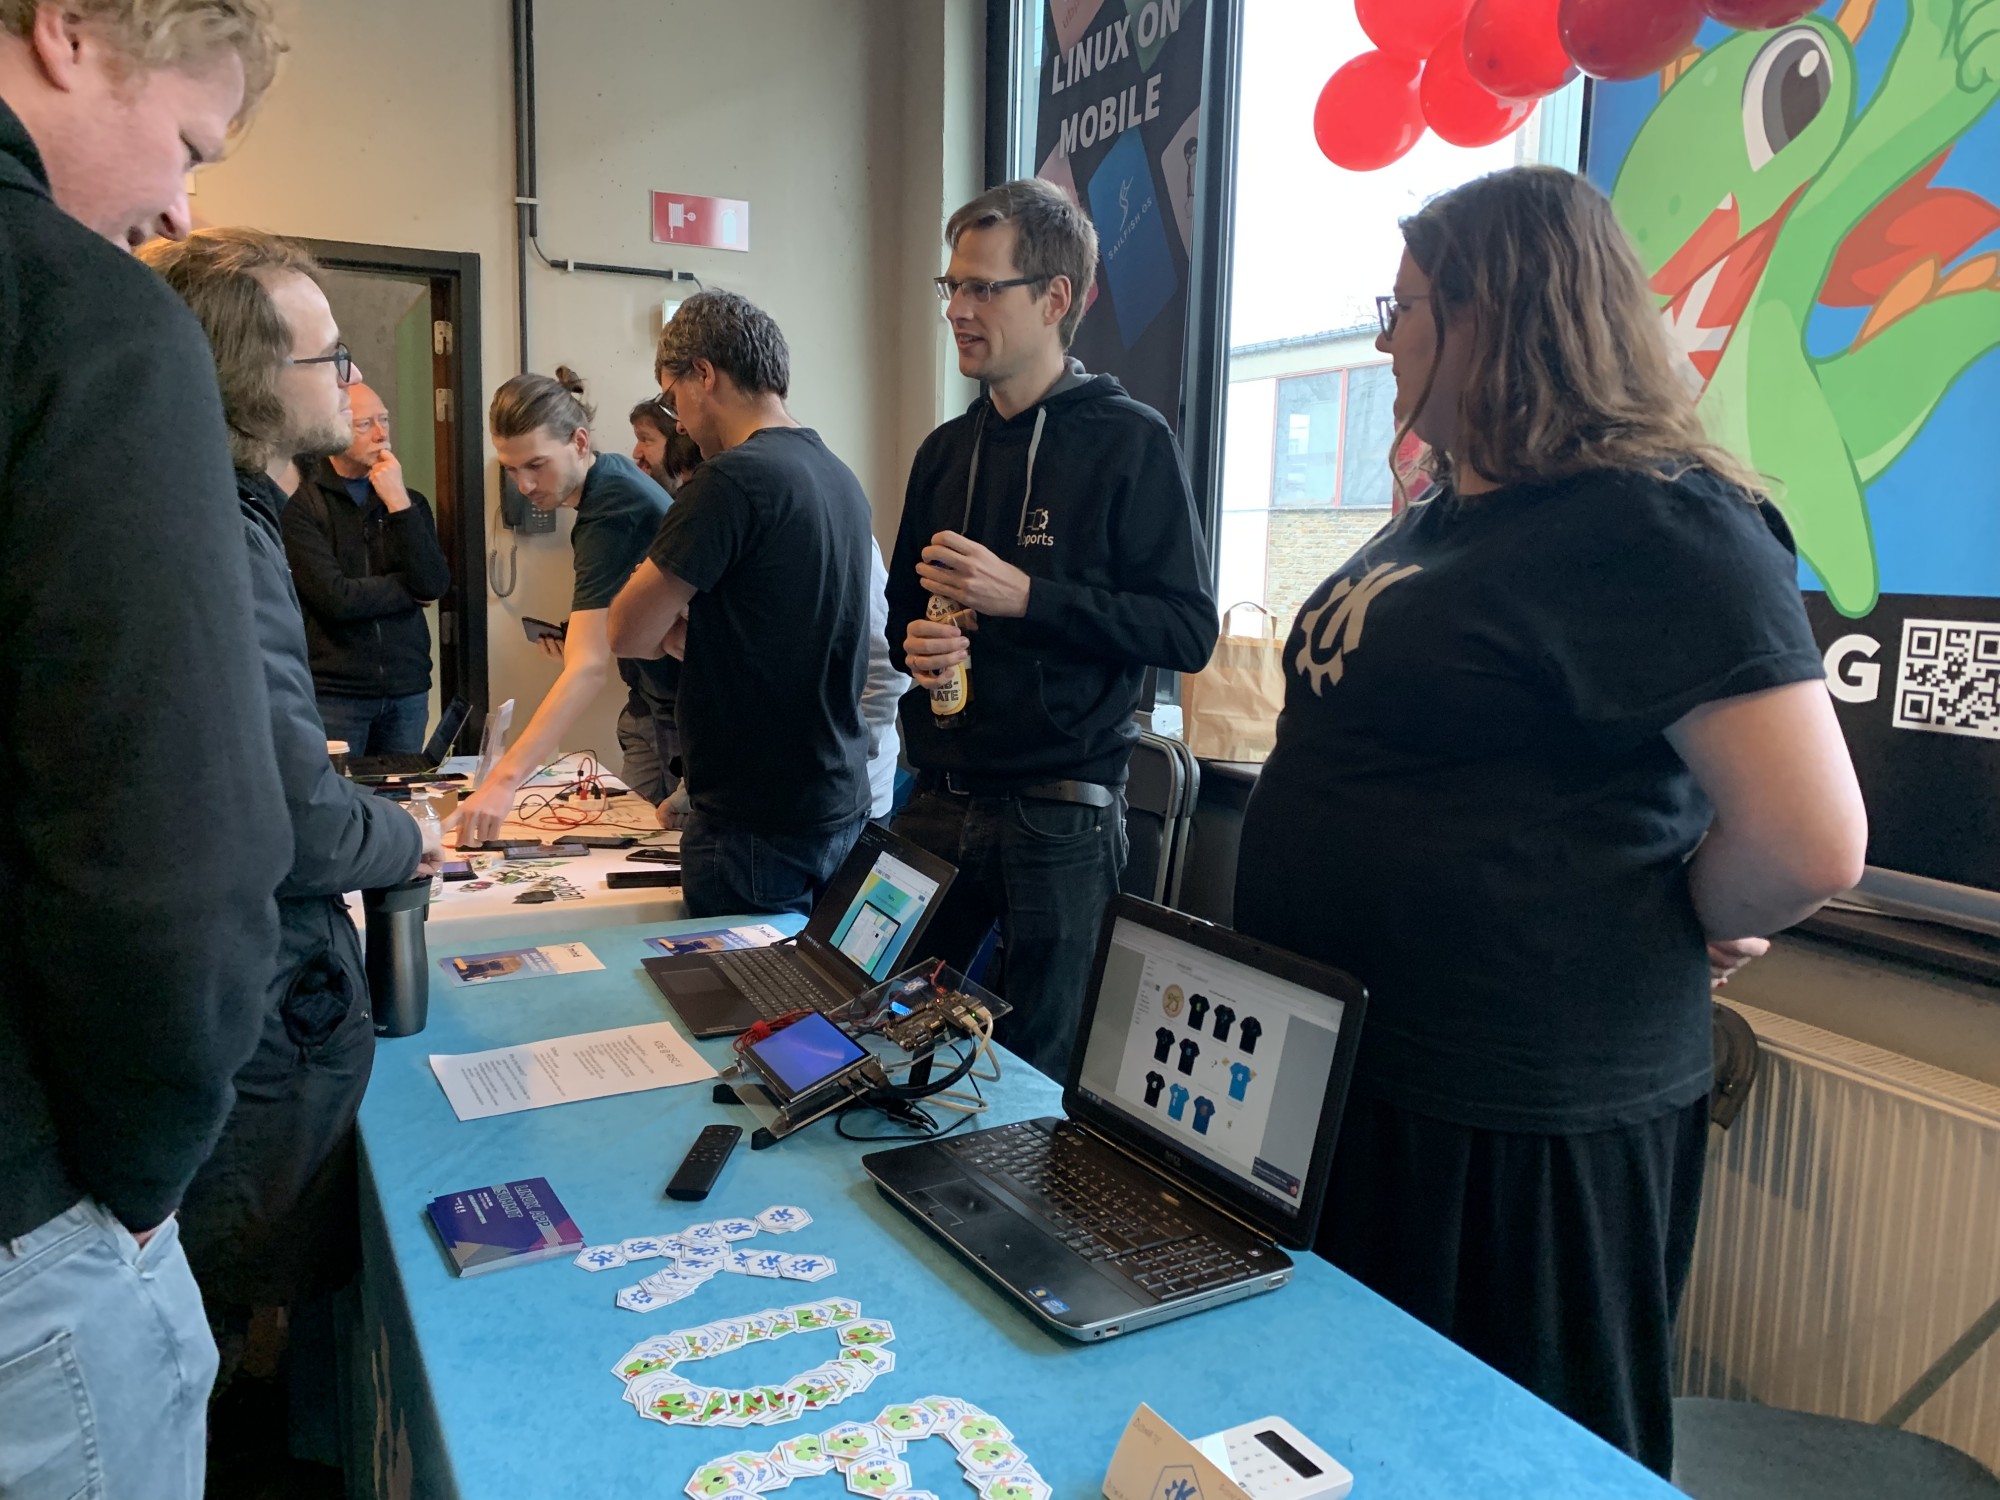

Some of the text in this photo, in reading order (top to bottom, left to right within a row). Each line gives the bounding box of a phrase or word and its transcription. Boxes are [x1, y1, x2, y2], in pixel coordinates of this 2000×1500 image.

[1051, 0, 1180, 95] LINUX ON
[1059, 72, 1162, 159] MOBILE
[1108, 196, 1152, 260] SAILFISH OS
[1019, 532, 1054, 548] ports
[494, 1188, 524, 1219] SUMMIT
[514, 1184, 551, 1228] LINUX APP
